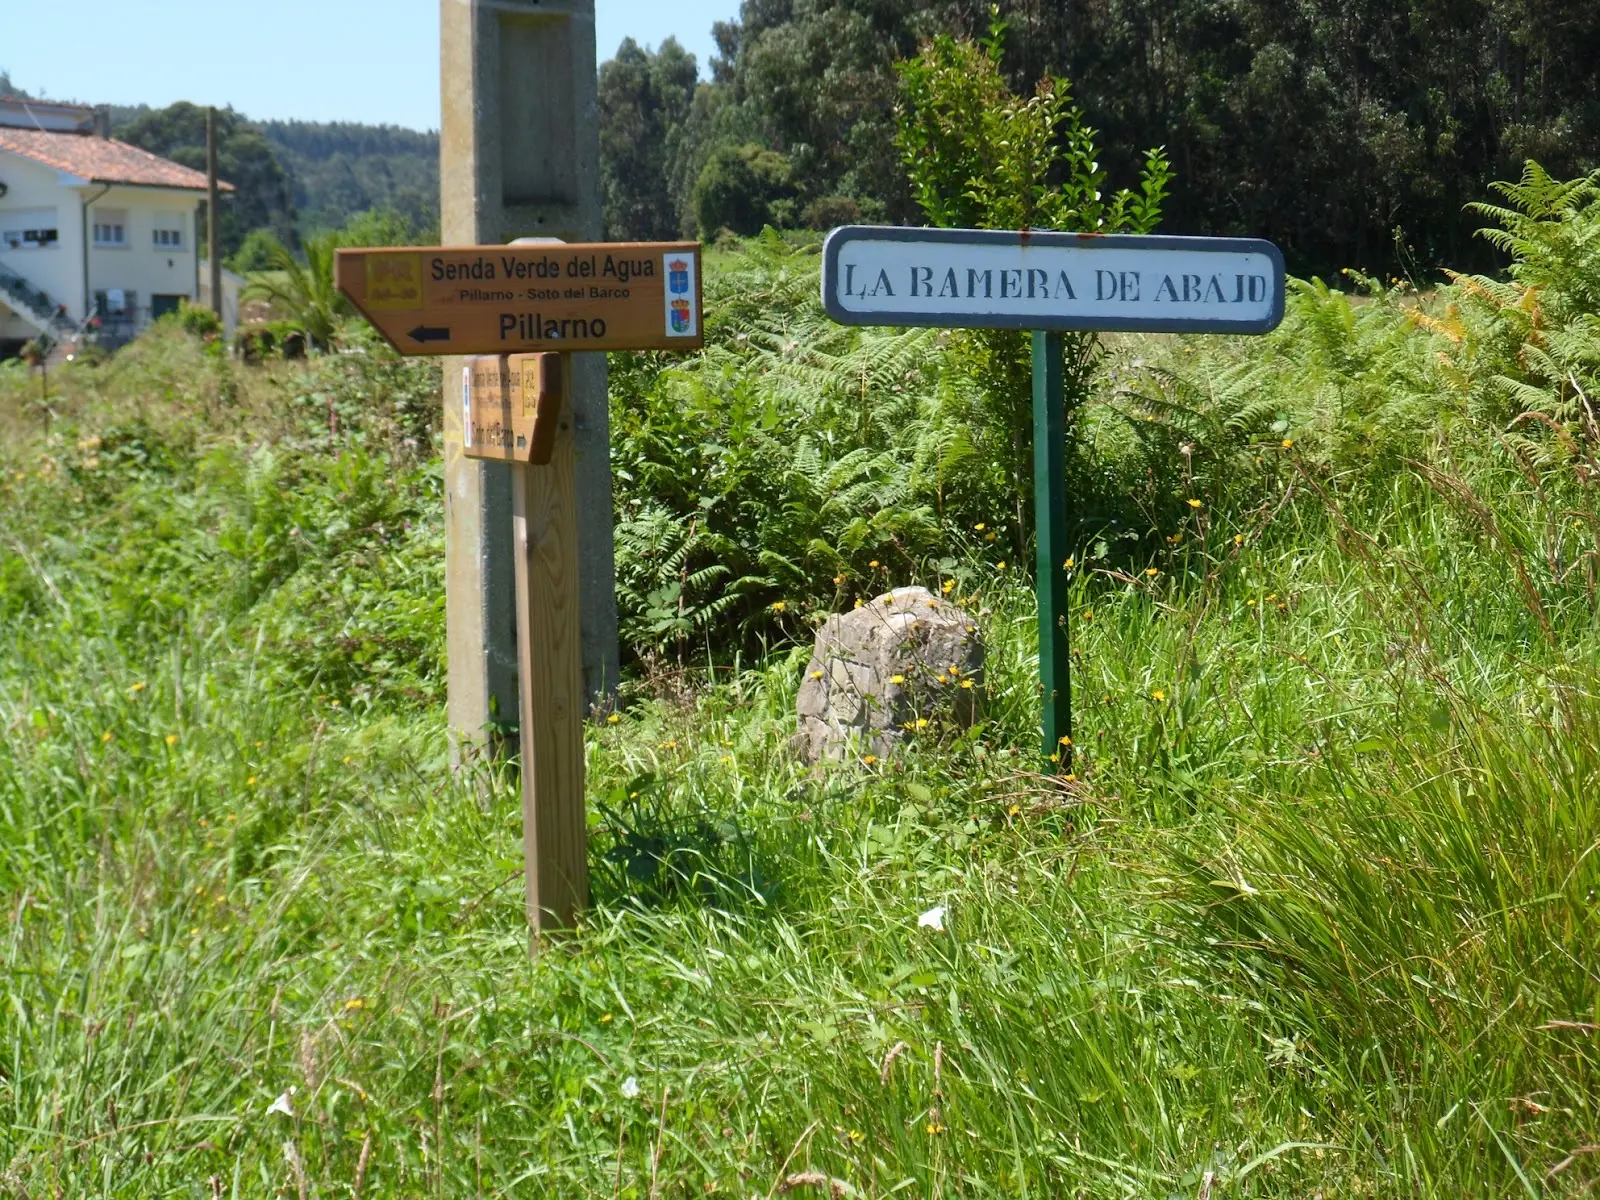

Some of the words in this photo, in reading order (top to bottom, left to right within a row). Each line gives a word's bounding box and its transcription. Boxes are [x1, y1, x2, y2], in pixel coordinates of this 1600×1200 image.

[431, 256, 496, 282] Senda
[502, 256, 560, 280] Verde
[566, 256, 596, 278] del
[602, 256, 655, 283] Agua
[844, 263, 896, 298] LA
[909, 266, 1078, 300] RAMERA
[1095, 269, 1141, 302] DE
[460, 288, 514, 302] Pillarno
[527, 287, 561, 300] Soto
[565, 287, 586, 299] del
[590, 286, 630, 299] Barco
[500, 313, 607, 341] Pillarno
